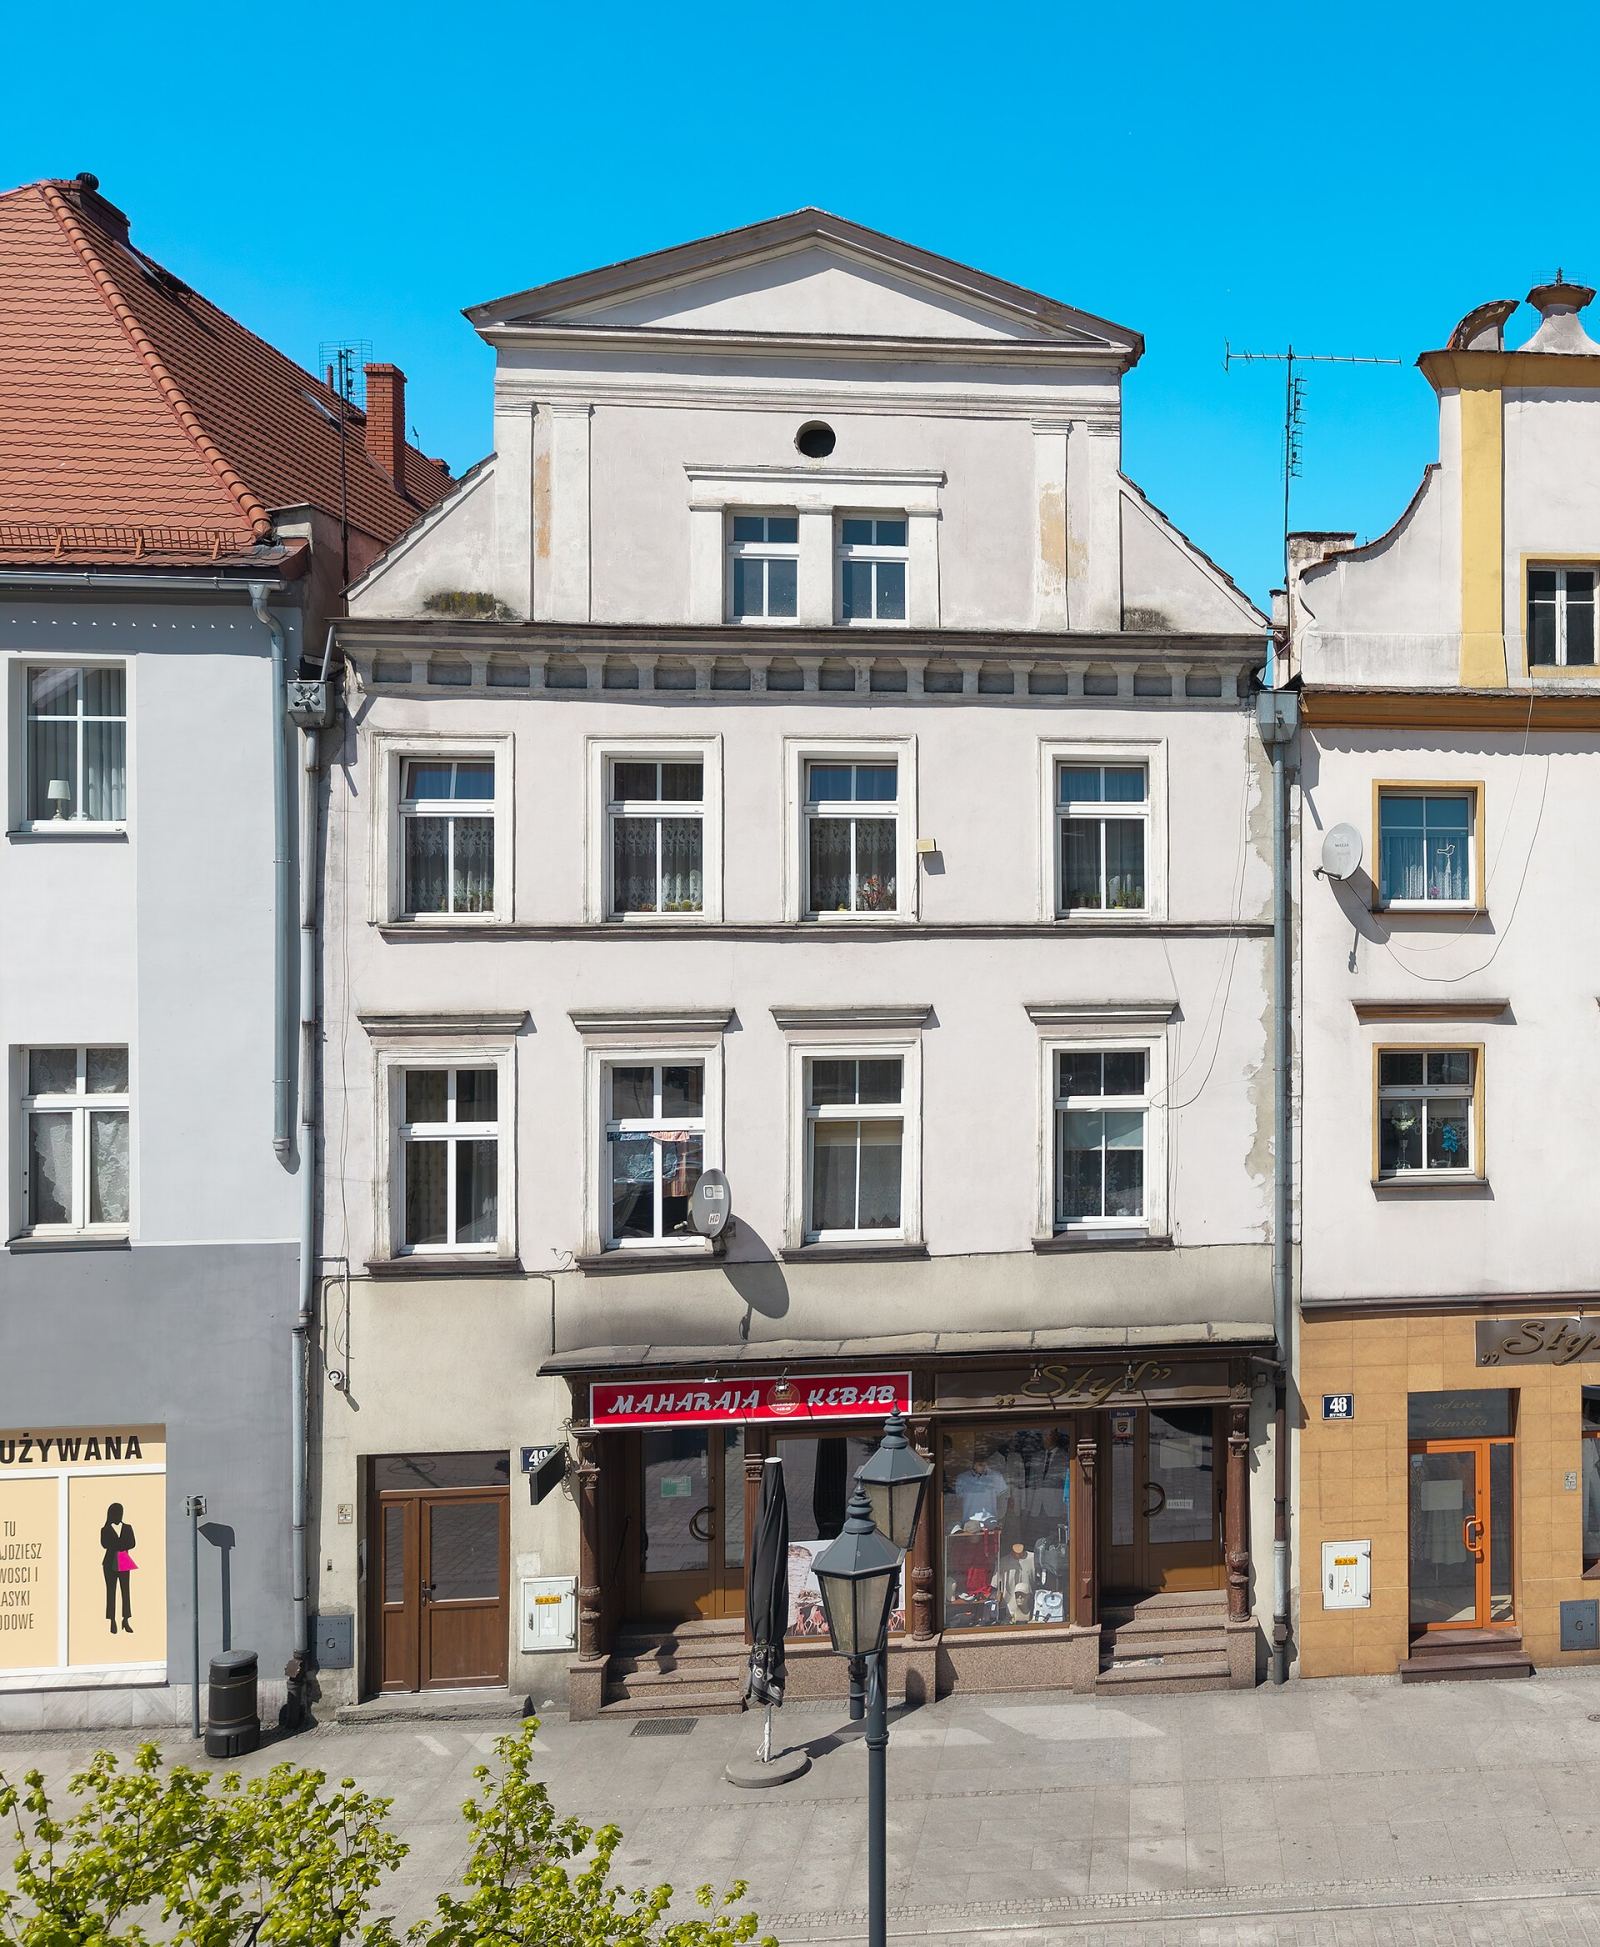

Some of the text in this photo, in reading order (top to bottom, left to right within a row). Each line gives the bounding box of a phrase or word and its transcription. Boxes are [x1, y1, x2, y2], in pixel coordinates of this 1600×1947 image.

[607, 1385, 896, 1414] MAHARAJA KEBAB
[1329, 1396, 1348, 1413] 48
[0, 1433, 143, 1464] UŻYWANA
[4, 1521, 16, 1537] TU
[0, 1543, 42, 1560] JDZIESZ
[35, 1566, 38, 1582] I
[0, 1590, 30, 1606] ASYKI
[326, 1637, 336, 1649] G
